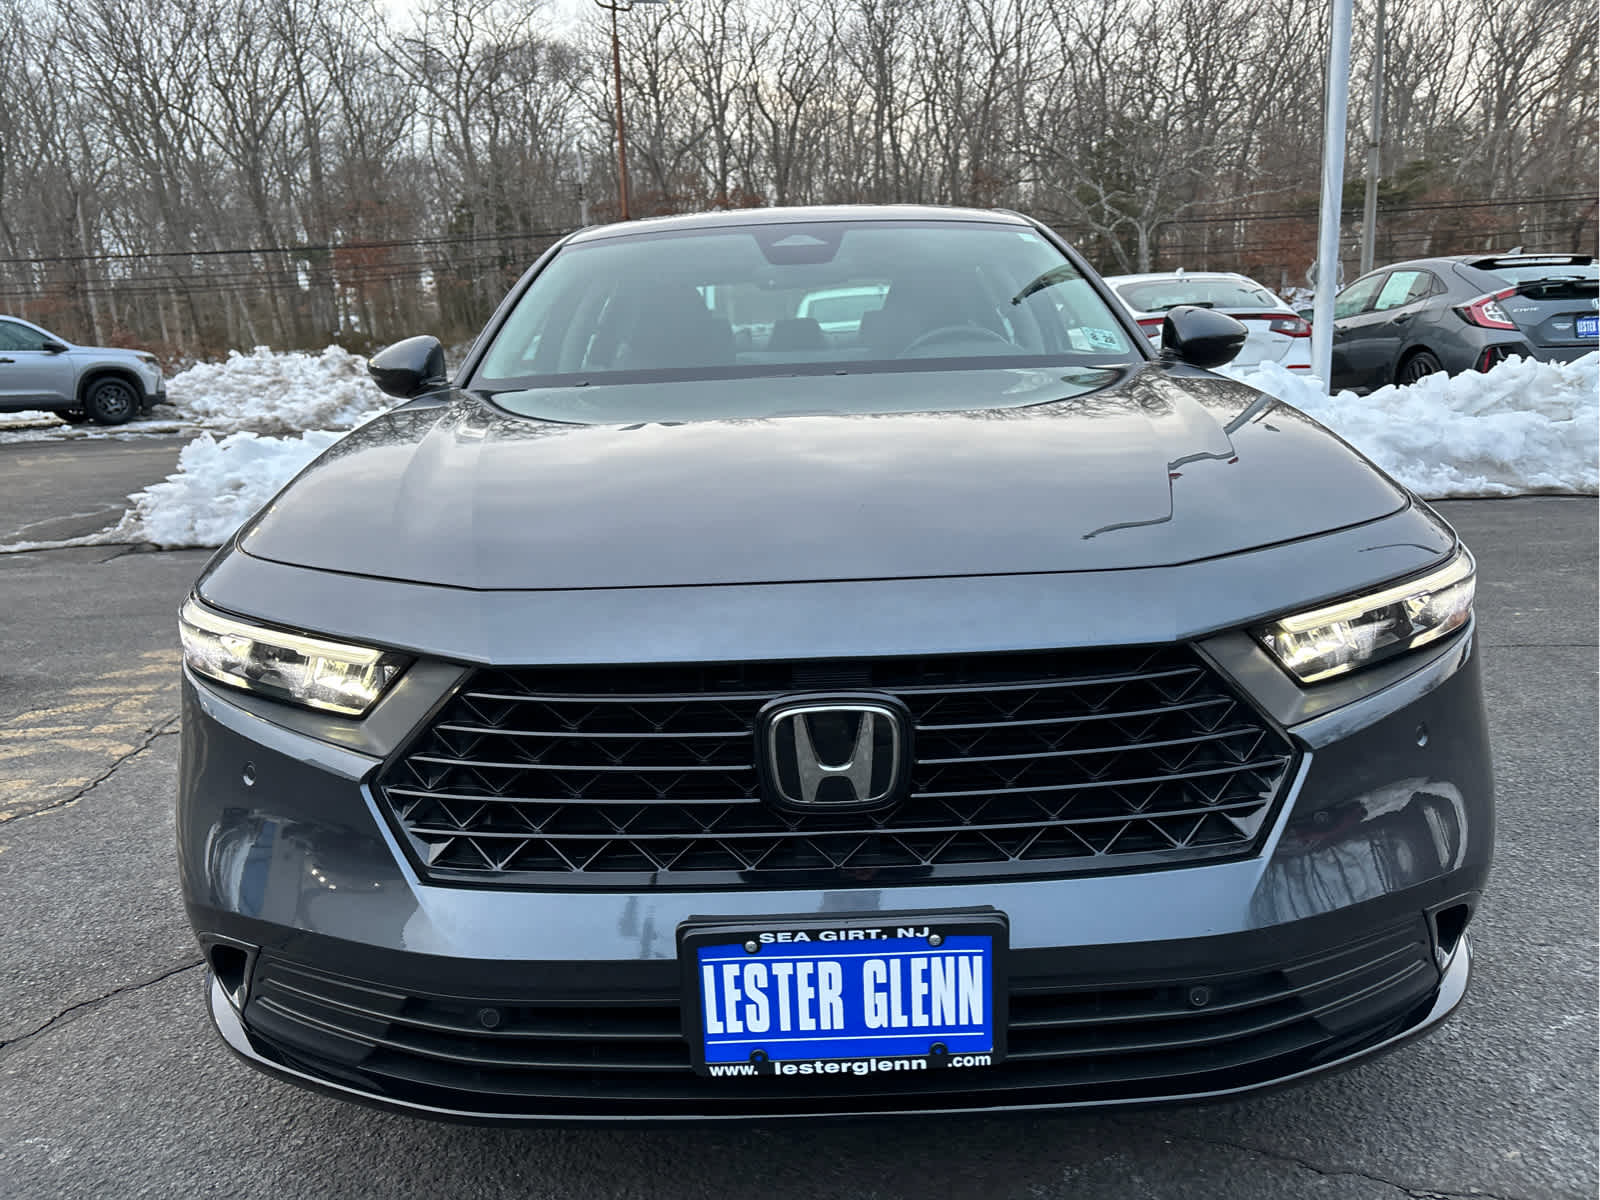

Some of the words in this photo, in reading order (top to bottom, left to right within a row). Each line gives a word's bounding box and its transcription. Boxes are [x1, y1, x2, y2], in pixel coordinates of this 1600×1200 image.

[759, 931, 813, 944] SEA
[819, 929, 888, 942] GIRT,
[896, 927, 930, 939] NJ
[702, 961, 845, 1034] LESTER
[862, 956, 983, 1029] GLENN
[709, 1063, 759, 1076] www.
[774, 1057, 927, 1075] lesterglenn
[947, 1055, 991, 1068] .com
